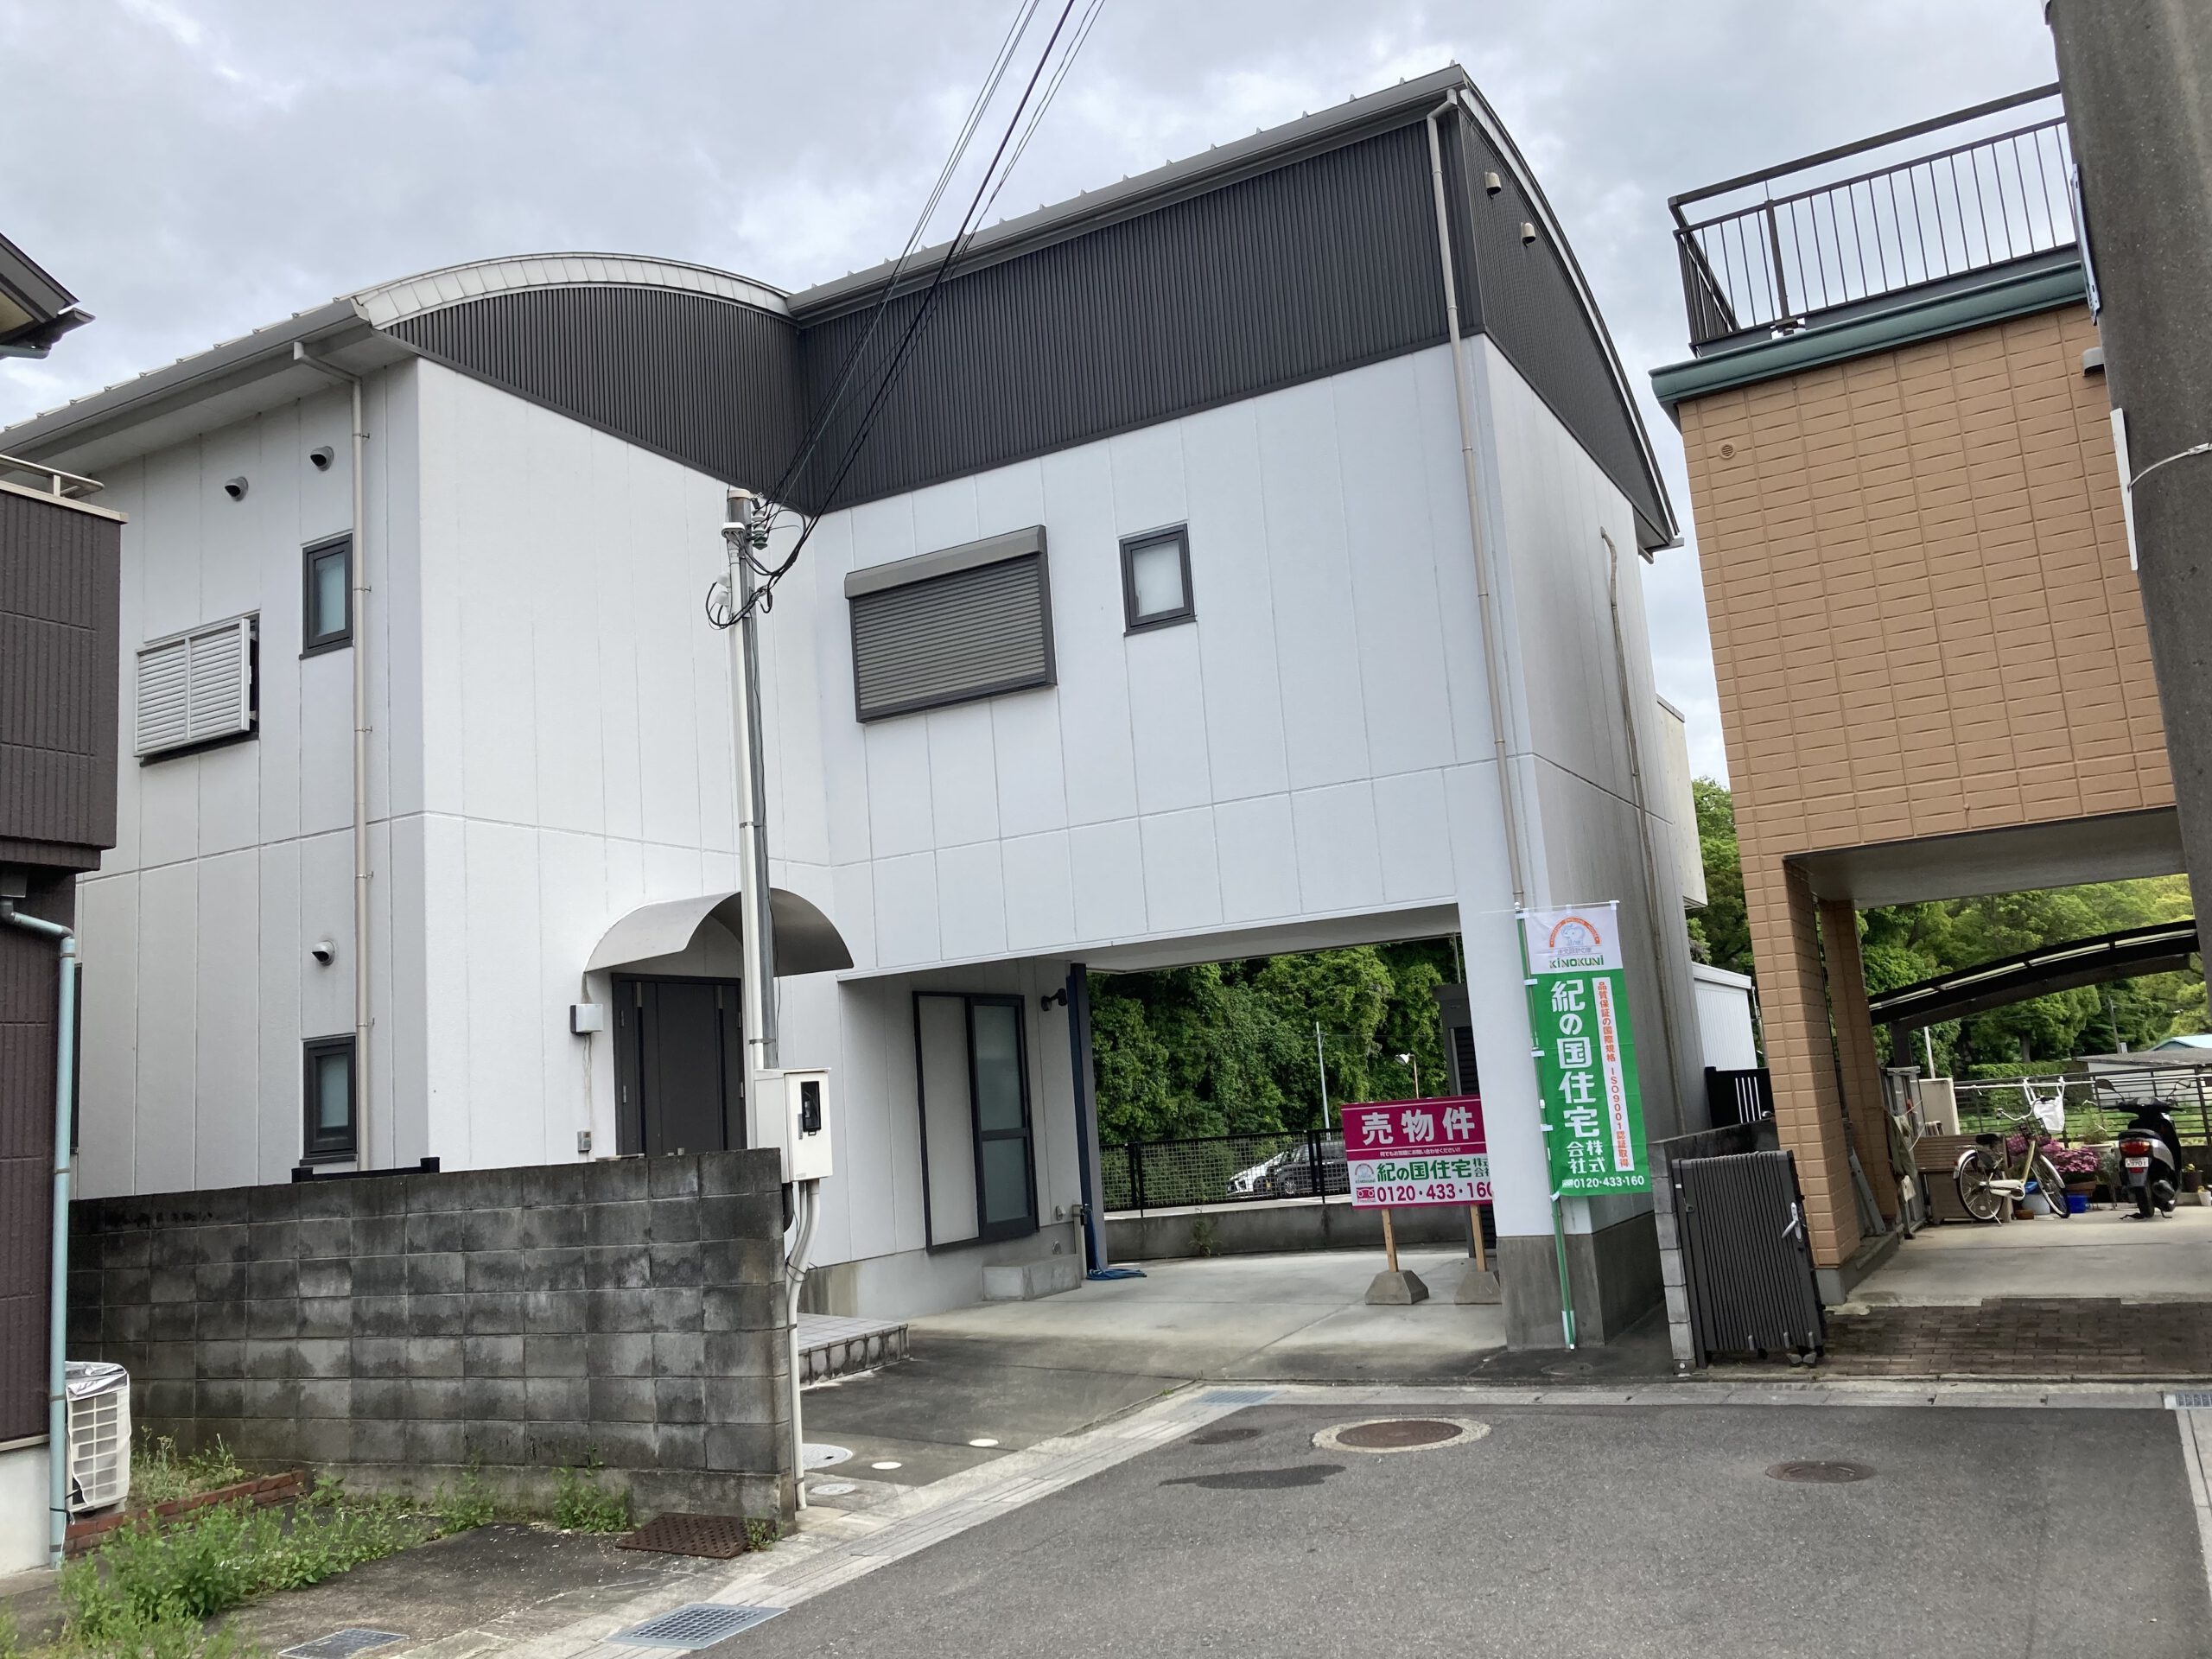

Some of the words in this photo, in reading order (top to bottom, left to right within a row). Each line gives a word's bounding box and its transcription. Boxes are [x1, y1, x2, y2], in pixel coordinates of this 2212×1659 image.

[1551, 979, 1599, 1138] 紀の国住宅
[1361, 1106, 1475, 1146] 売物件
[1377, 1159, 1471, 1182] 紀の国住宅
